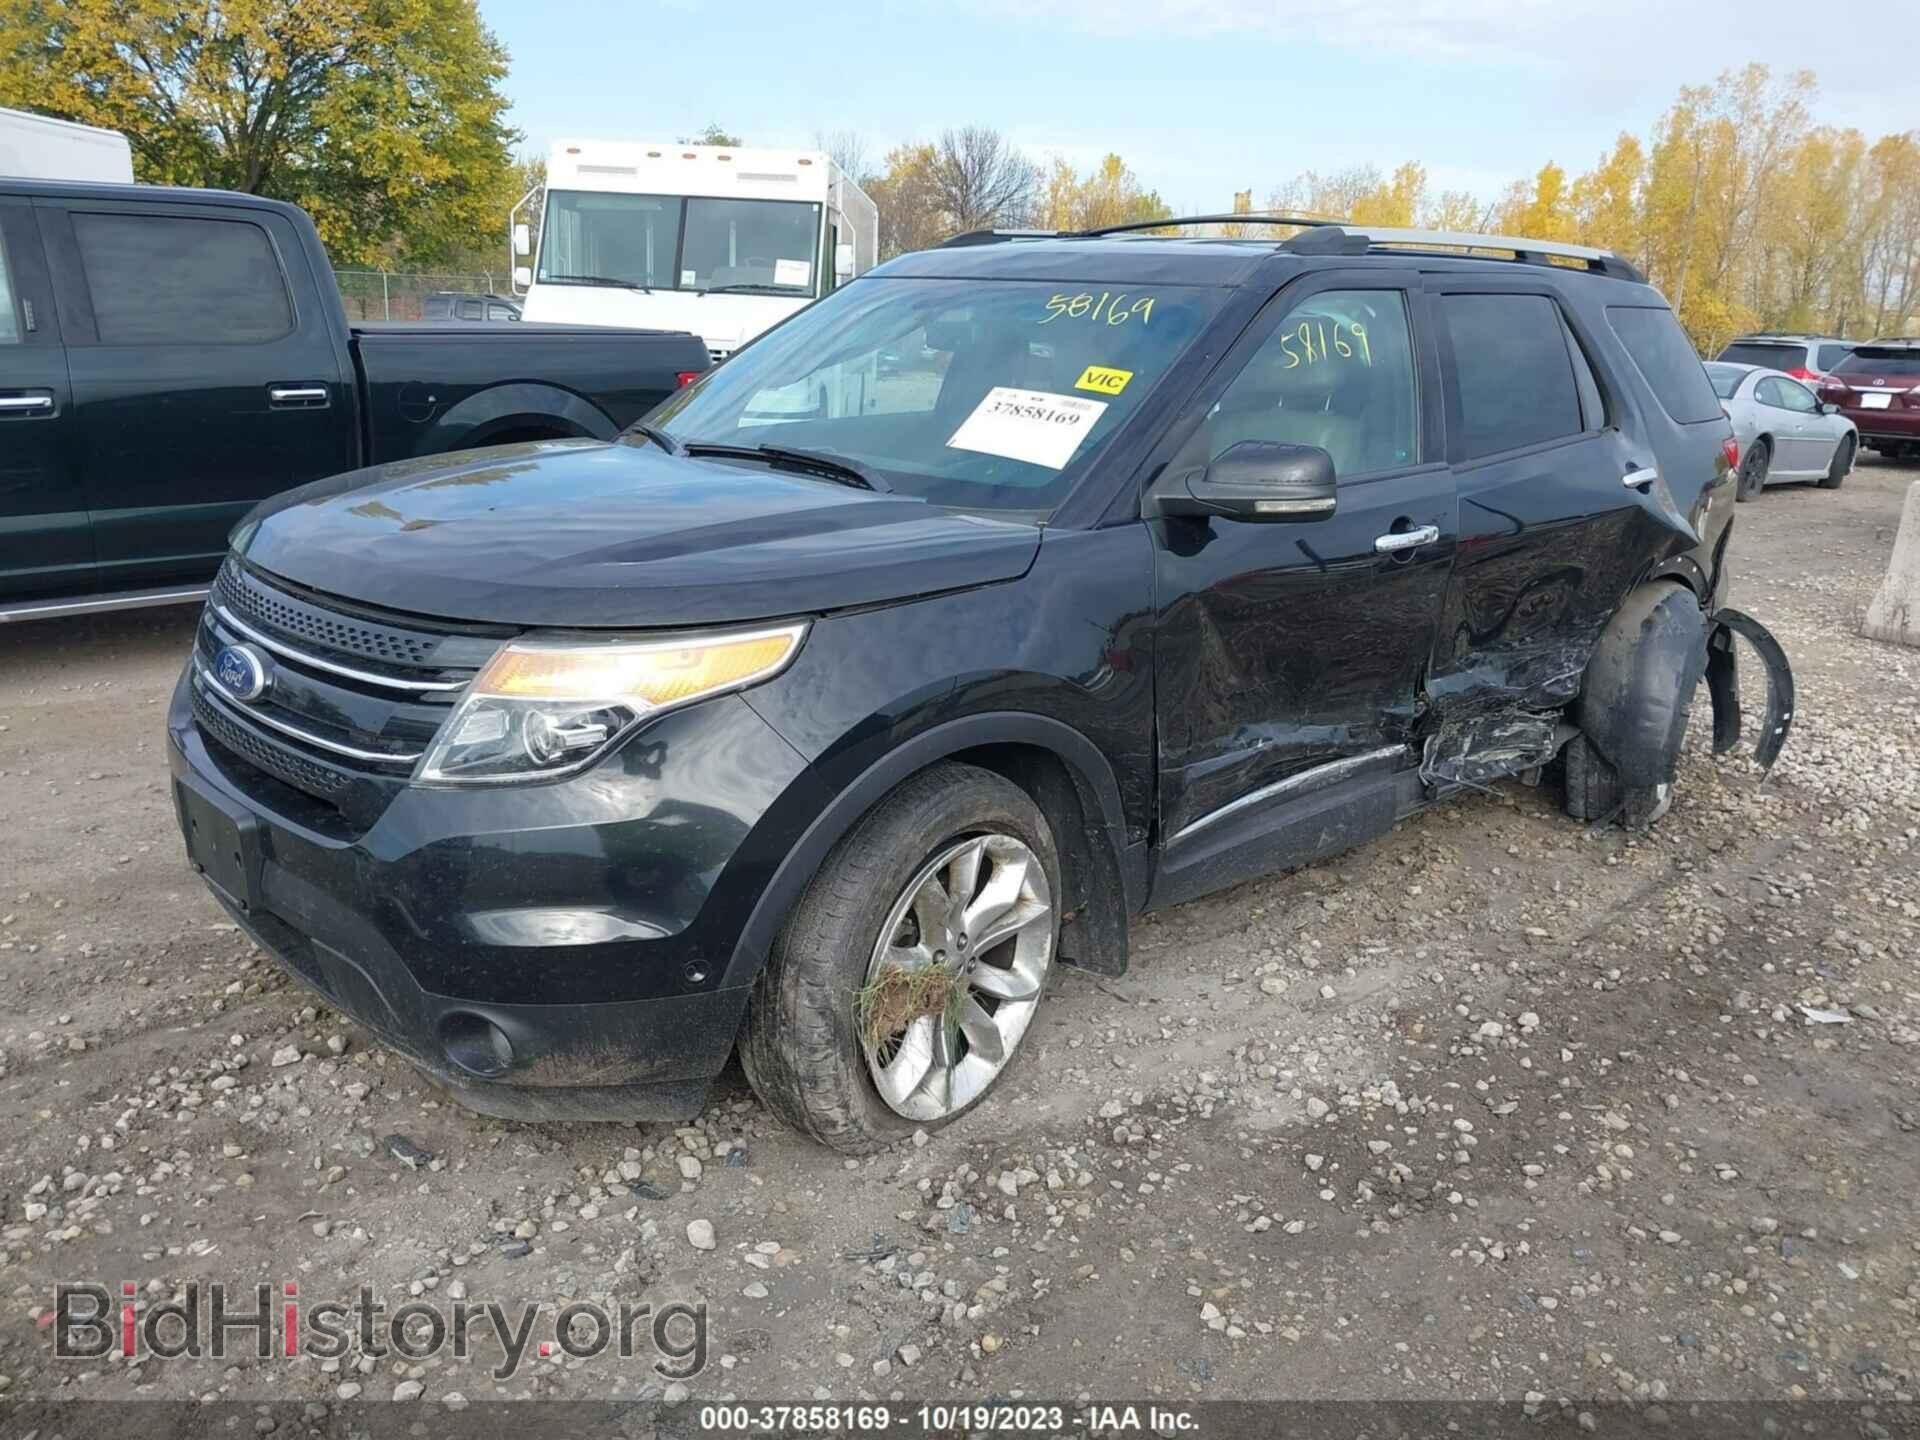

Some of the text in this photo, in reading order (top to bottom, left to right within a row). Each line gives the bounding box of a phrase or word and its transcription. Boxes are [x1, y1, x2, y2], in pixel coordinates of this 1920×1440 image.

[1036, 292, 1156, 326] 58169
[1280, 321, 1372, 369] 58169
[1086, 371, 1125, 389] VIC
[986, 401, 1081, 425] 37858169
[220, 652, 247, 688] Ford
